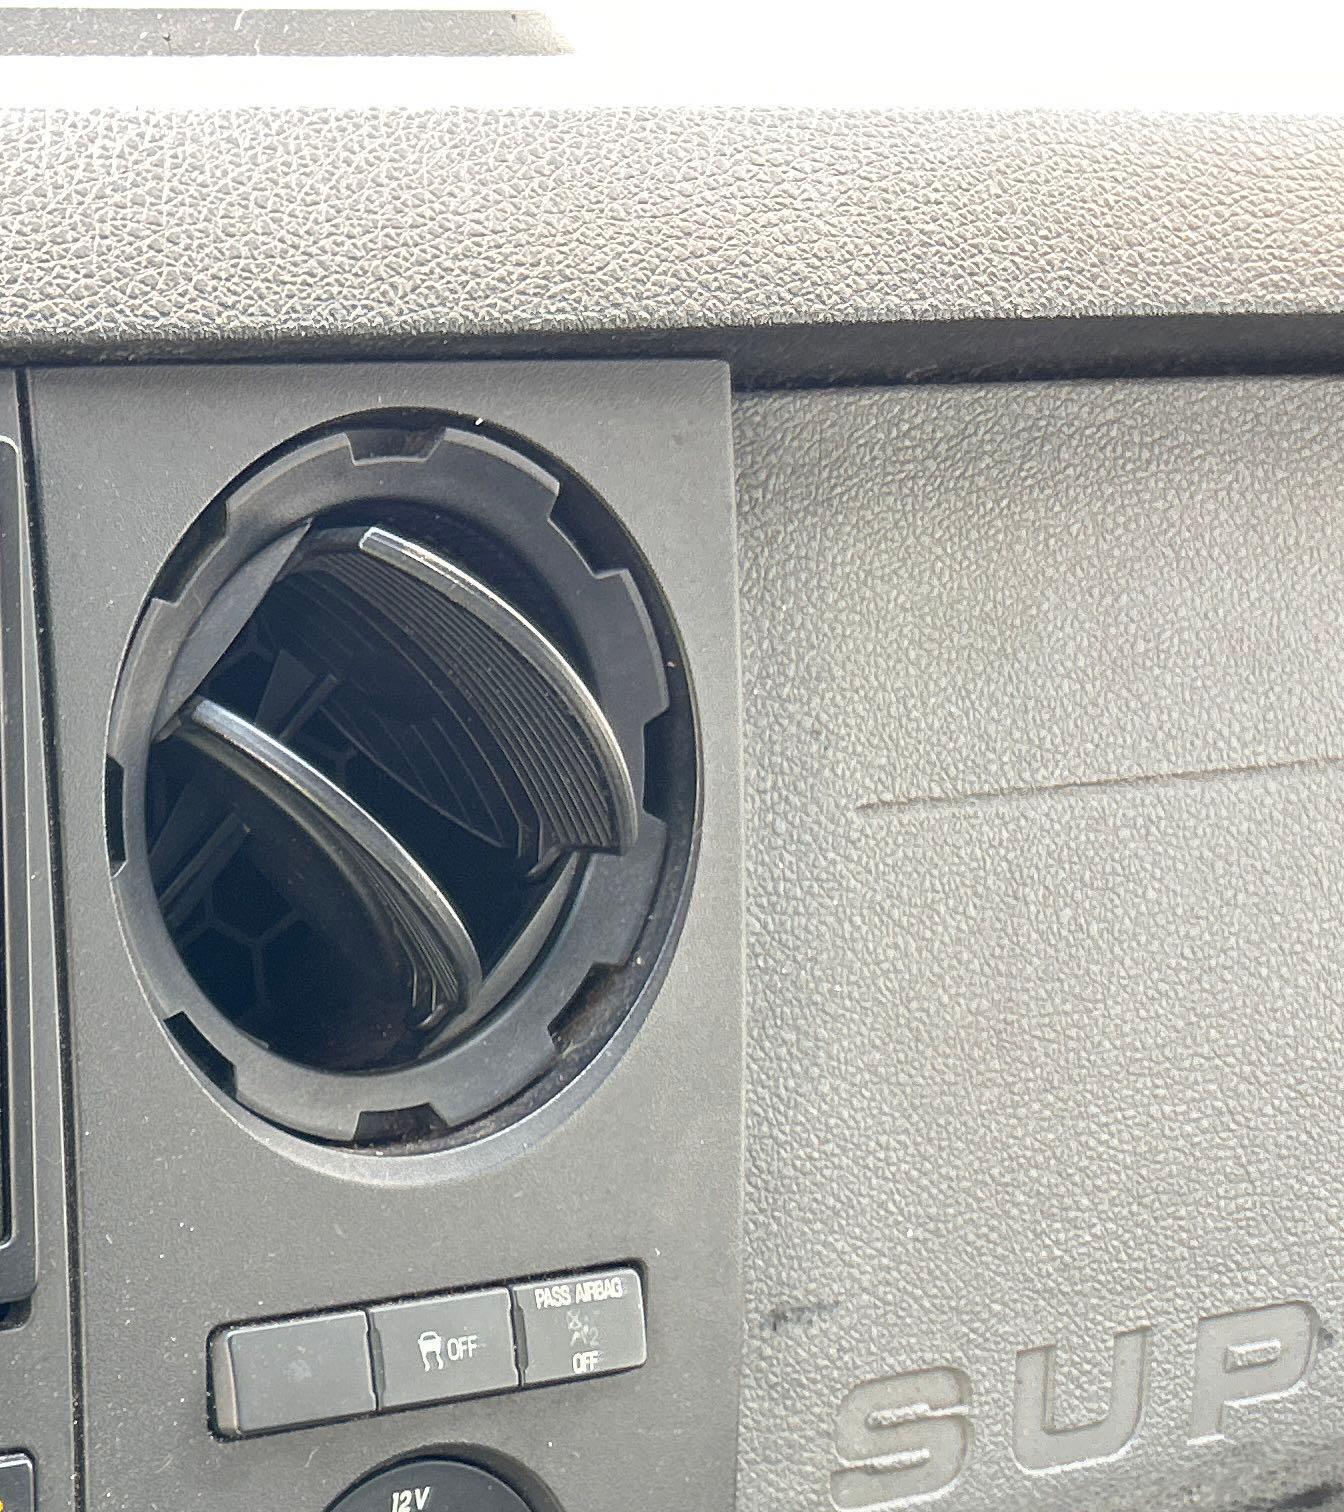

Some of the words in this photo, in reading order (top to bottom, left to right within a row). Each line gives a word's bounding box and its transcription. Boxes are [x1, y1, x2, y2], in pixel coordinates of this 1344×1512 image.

[534, 1285, 572, 1310] PASS
[575, 1277, 623, 1304] AIRBAG
[446, 1336, 479, 1361] OFF
[572, 1350, 600, 1375] OFF
